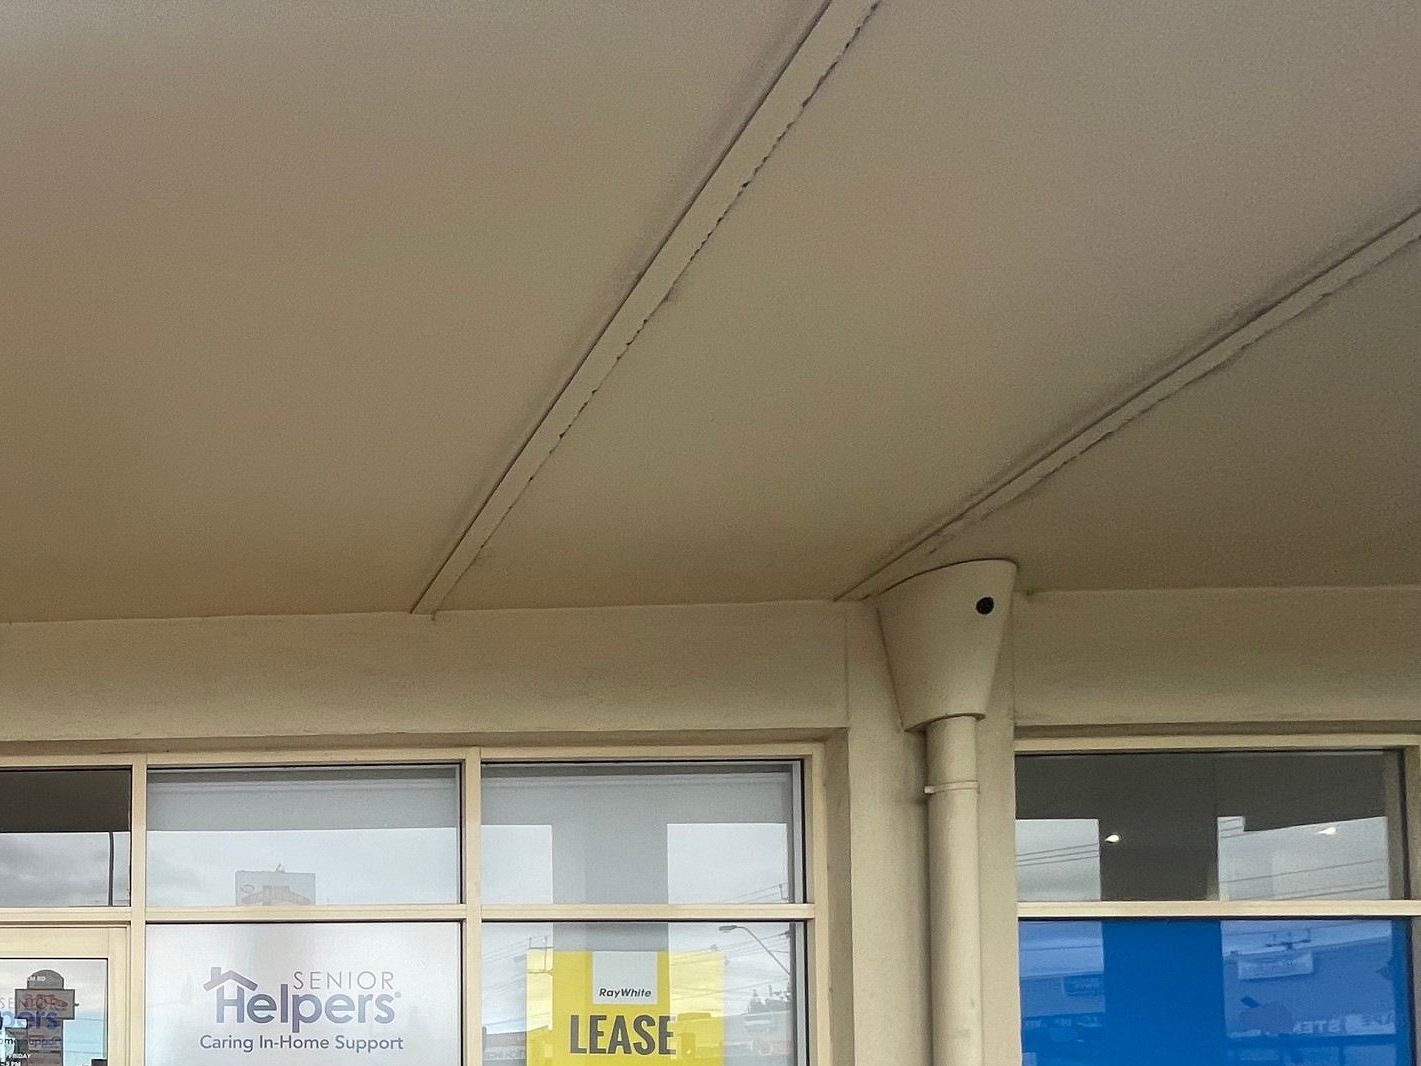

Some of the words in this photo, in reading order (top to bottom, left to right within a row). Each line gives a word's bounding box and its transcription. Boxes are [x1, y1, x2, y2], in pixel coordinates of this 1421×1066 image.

[293, 971, 395, 990] SENIOR
[599, 988, 652, 999] RayWhite
[216, 983, 397, 1033] Helpers
[200, 1035, 254, 1053] Caring
[259, 1036, 329, 1050] In-Home
[335, 1036, 404, 1053] Support
[570, 1014, 676, 1056] LEASE
